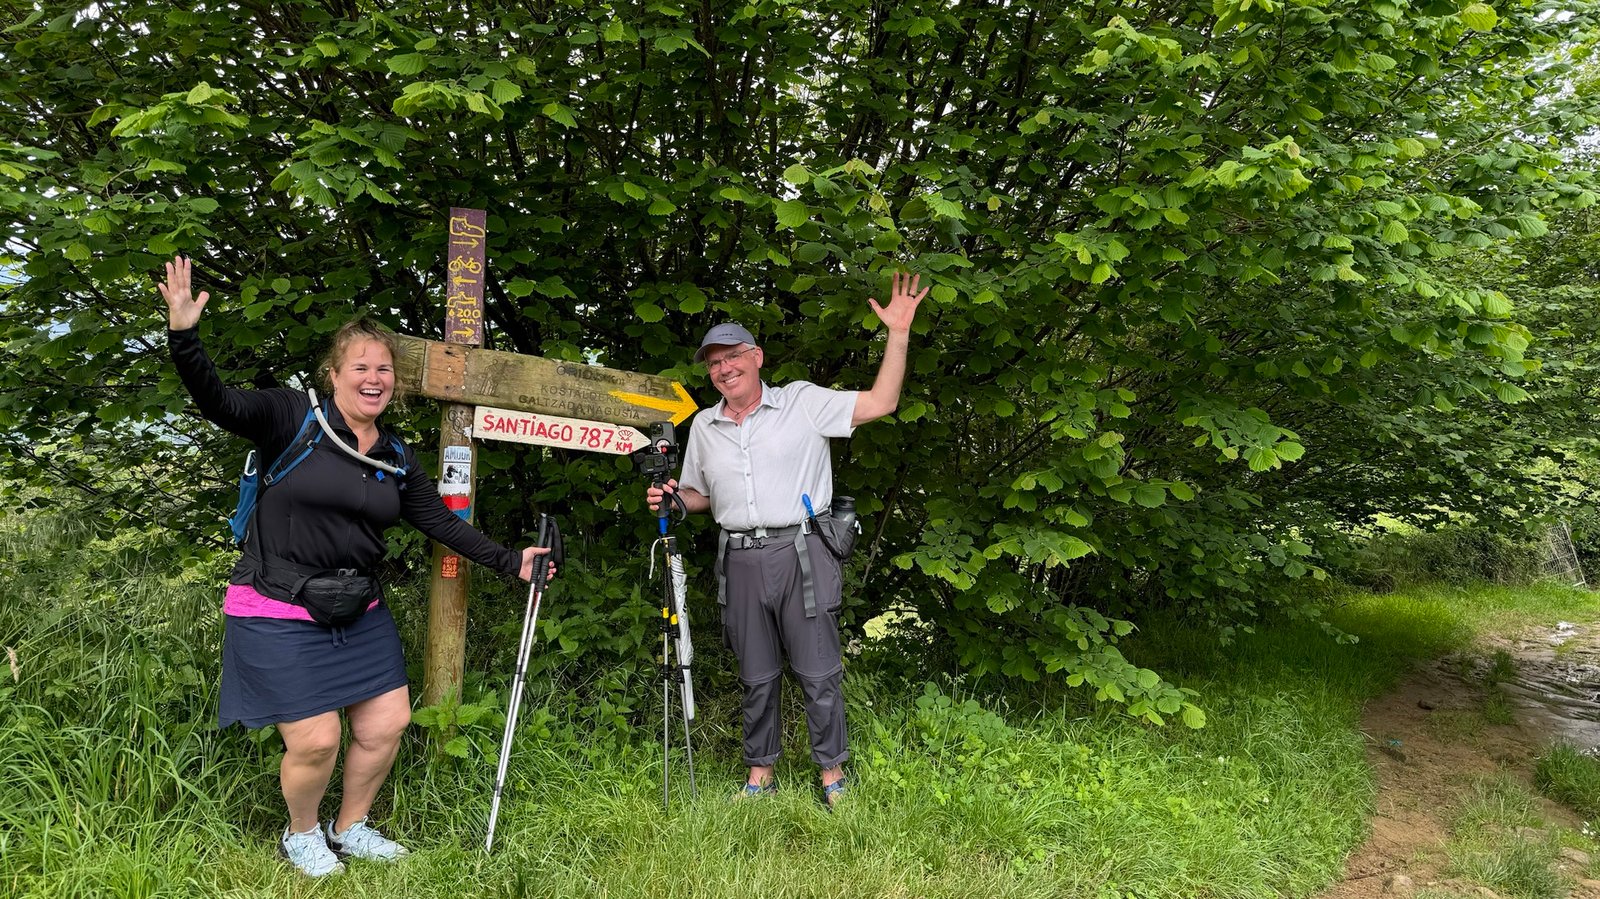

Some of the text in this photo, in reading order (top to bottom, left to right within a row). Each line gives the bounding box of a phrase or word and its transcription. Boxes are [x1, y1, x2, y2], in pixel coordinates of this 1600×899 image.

[457, 308, 481, 319] 200
[579, 426, 615, 449] 787
[615, 441, 633, 453] KM
